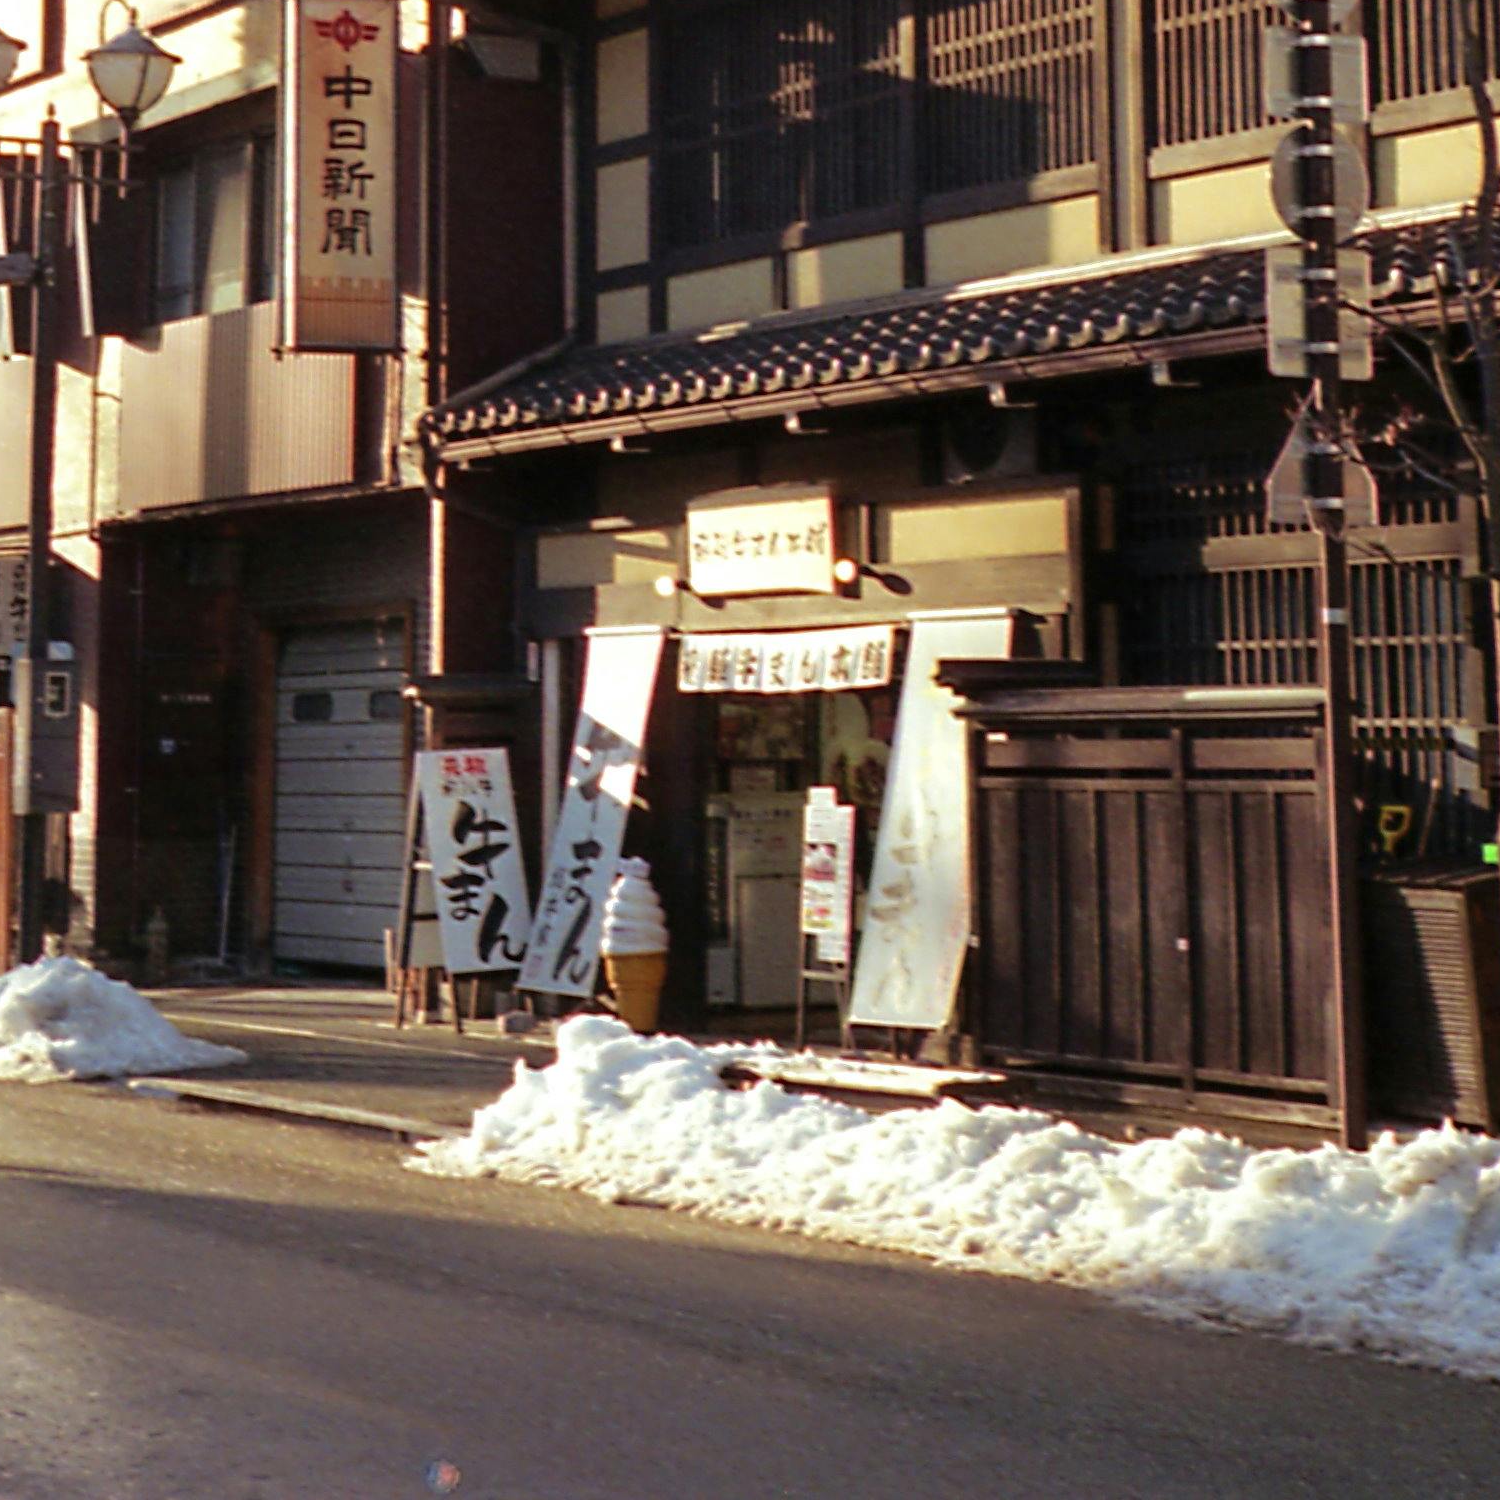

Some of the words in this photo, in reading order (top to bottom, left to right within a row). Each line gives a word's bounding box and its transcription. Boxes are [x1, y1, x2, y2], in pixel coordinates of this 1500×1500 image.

[321, 65, 374, 256] 中日新聞
[441, 800, 528, 964] 牛まん
